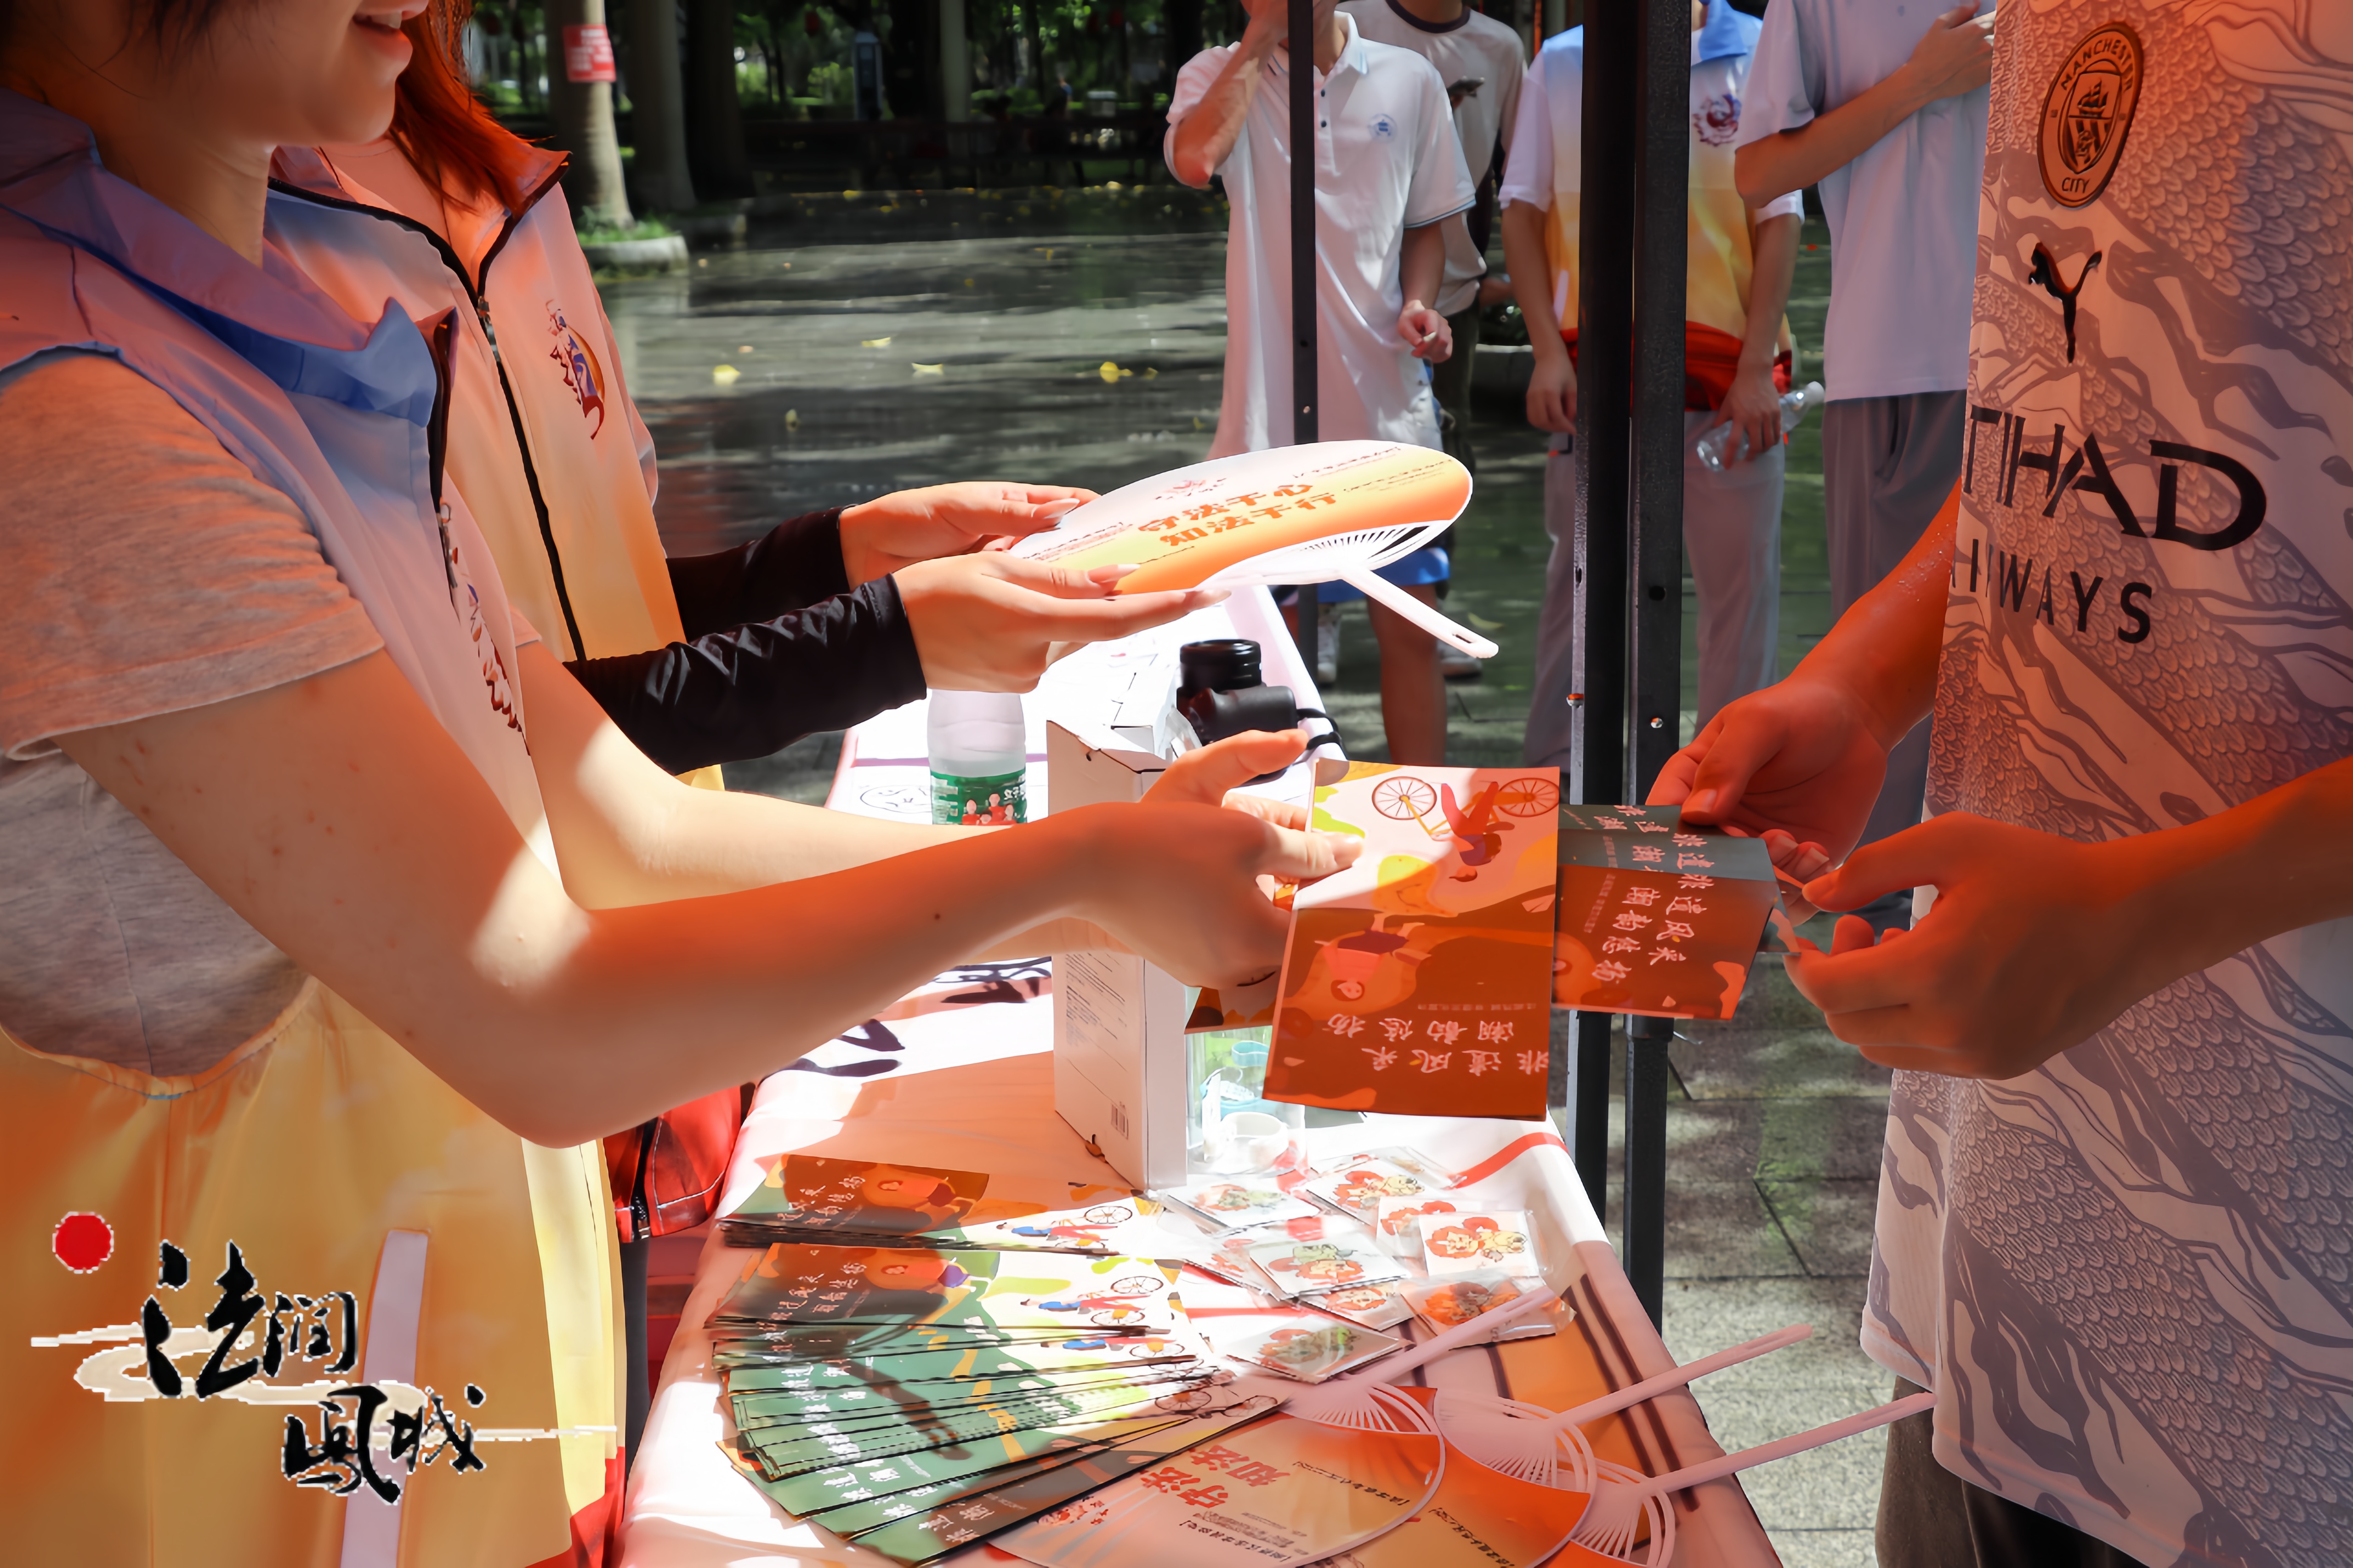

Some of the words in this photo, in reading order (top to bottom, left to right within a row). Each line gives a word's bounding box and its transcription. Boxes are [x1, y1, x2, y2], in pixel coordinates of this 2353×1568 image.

[2061, 176, 2091, 194] CITY
[1138, 483, 1313, 532] 守法于心
[1159, 493, 1336, 546] 知法于行
[1951, 539, 2152, 643] IWAYS
[1648, 873, 1714, 966] 非遗风采
[1322, 1014, 1514, 1045] 潮韵悠扬
[1361, 1046, 1549, 1077] 非遗风采
